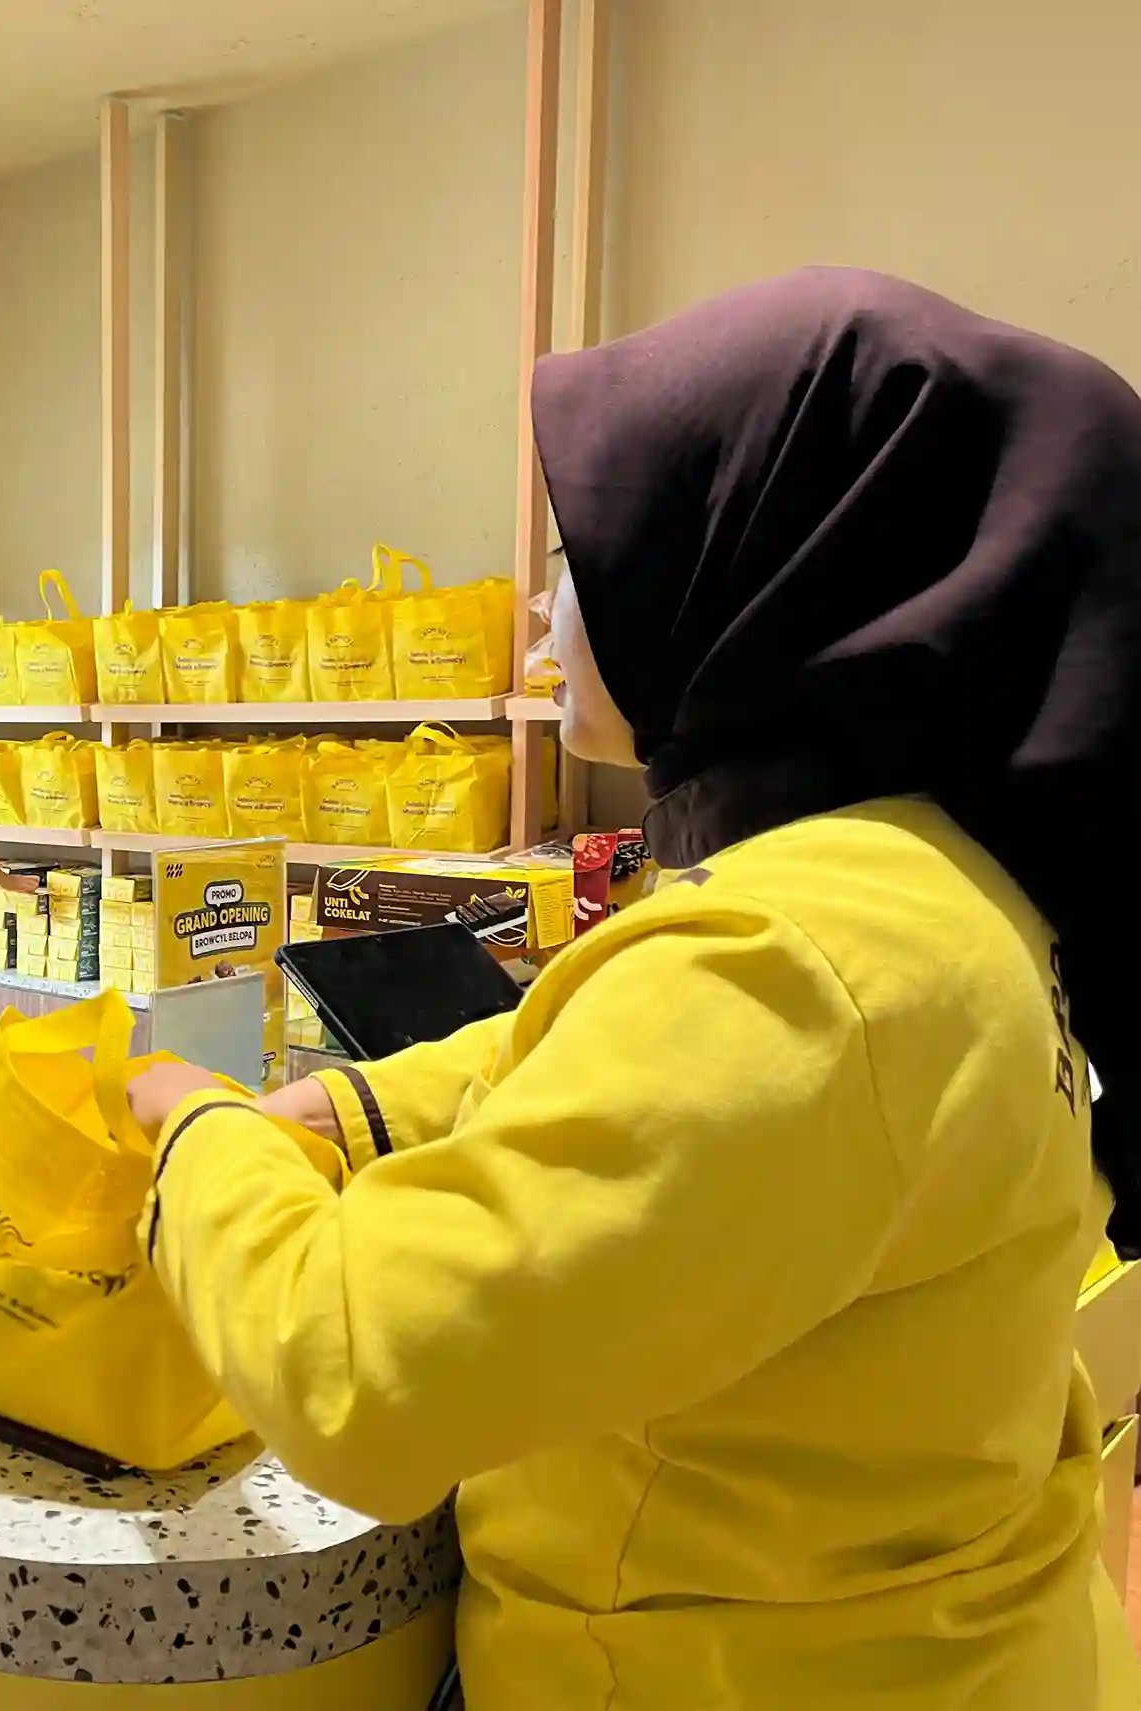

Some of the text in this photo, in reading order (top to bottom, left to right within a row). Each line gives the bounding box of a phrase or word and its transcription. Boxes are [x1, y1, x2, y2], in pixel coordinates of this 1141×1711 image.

[211, 888, 237, 900] PROMO
[324, 896, 348, 908] UNTI
[176, 906, 268, 934] GRAND OPENING
[324, 907, 371, 920] COKELAT
[194, 930, 253, 948] BROWCYL BELOPA
